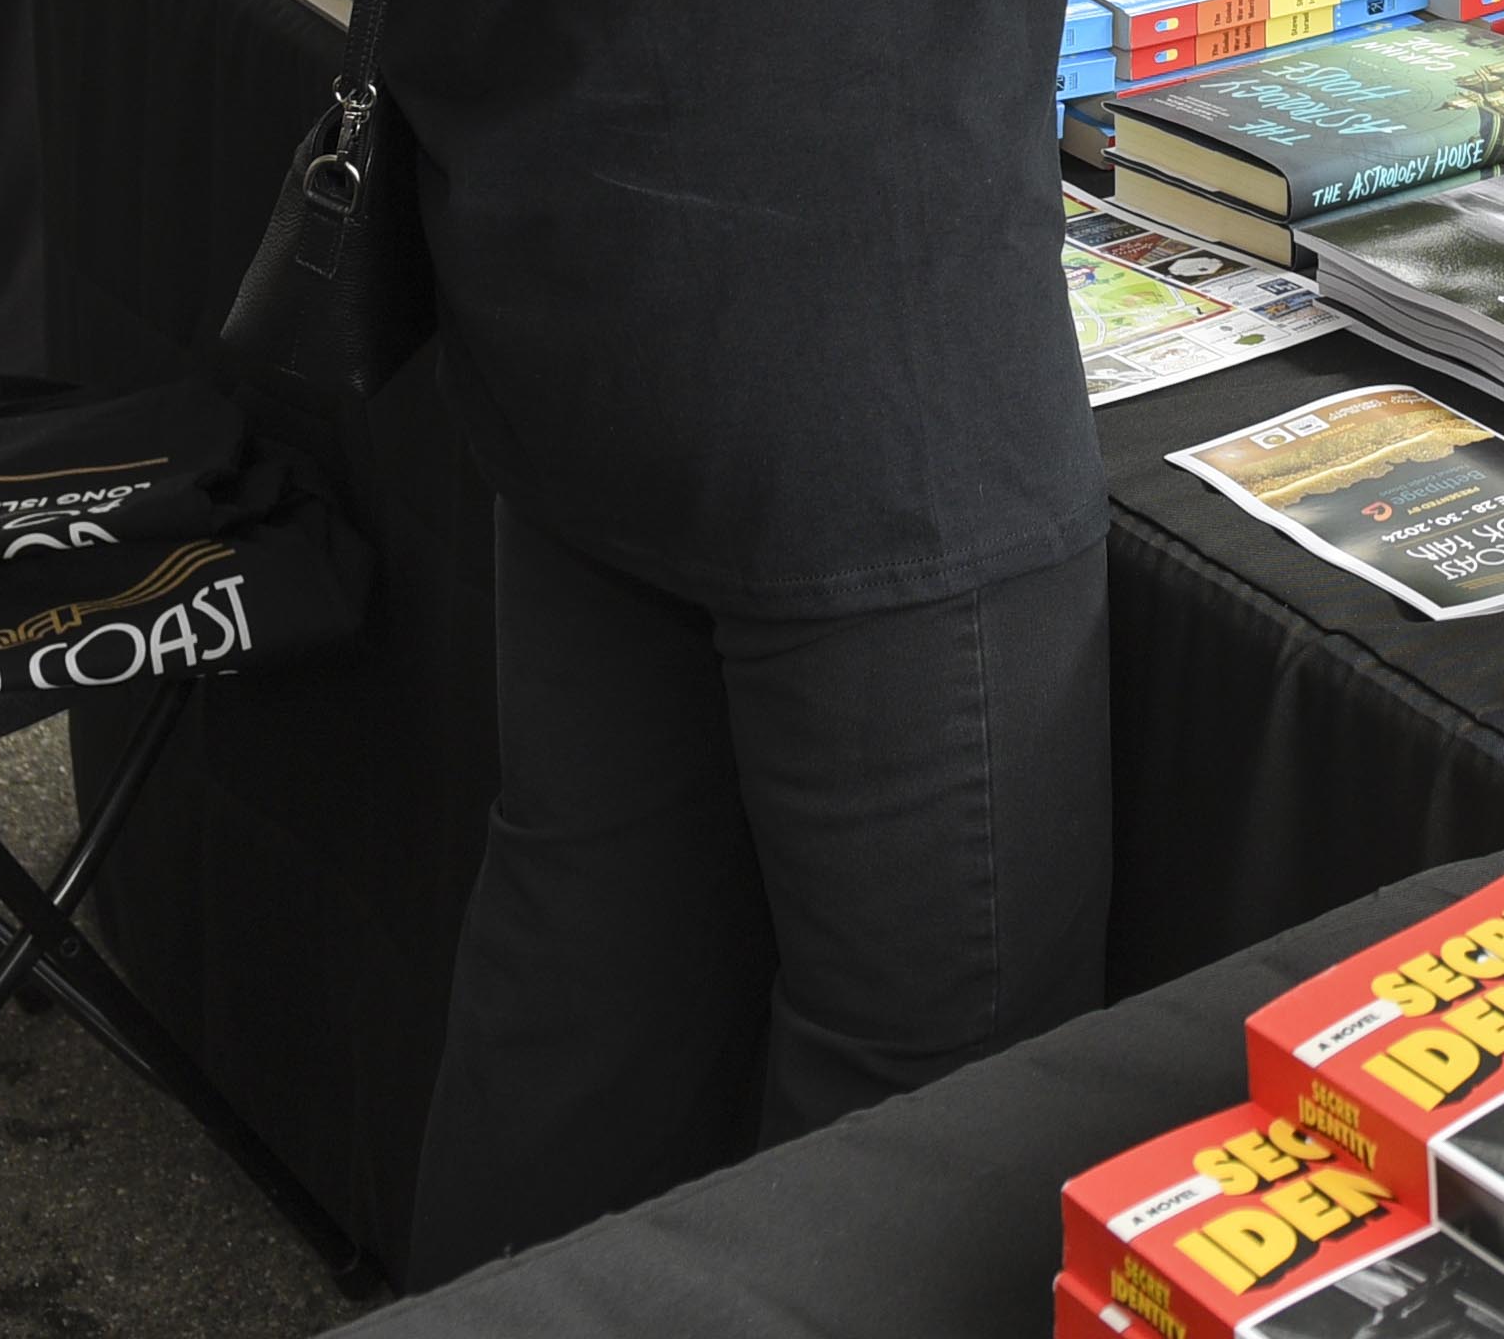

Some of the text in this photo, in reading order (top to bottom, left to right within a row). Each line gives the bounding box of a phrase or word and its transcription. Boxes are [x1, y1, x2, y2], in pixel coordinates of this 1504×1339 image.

[1356, 40, 1457, 70] CARINN
[1396, 35, 1471, 58] JADE
[1269, 60, 1413, 102] HOUSE
[1200, 80, 1408, 135] ASTROLOGY
[1229, 120, 1312, 146] THE
[1312, 182, 1341, 208] THE
[1347, 155, 1430, 202] ASTROLOGY
[1433, 139, 1484, 178] HOUSE
[57, 481, 151, 507] LONG
[28, 574, 252, 690] COAST
[1330, 1010, 1382, 1046] NOVEL
